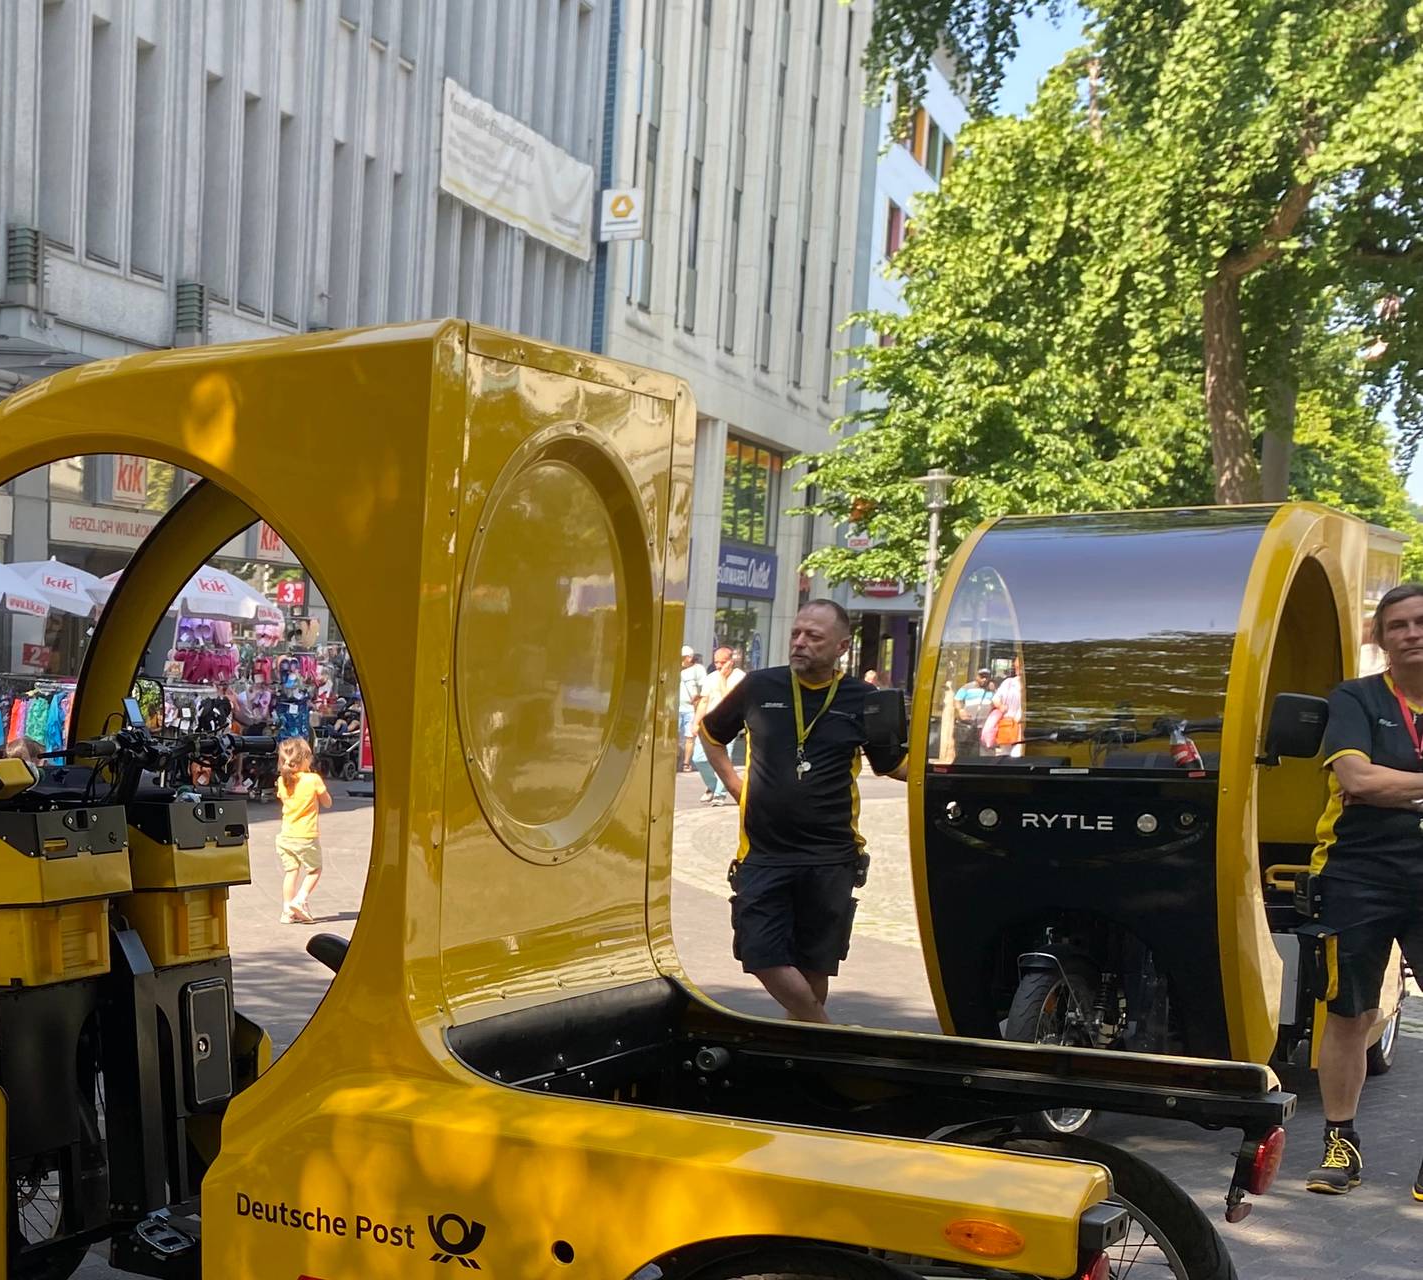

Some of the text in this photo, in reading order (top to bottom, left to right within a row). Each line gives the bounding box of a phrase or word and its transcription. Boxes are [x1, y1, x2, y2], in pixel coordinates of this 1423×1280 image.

[68, 516, 113, 534] HERZLICH
[45, 577, 73, 590] kik
[199, 577, 226, 593] kik
[1022, 813, 1114, 831] RYTLE
[236, 1192, 415, 1249] Deutsche Post
